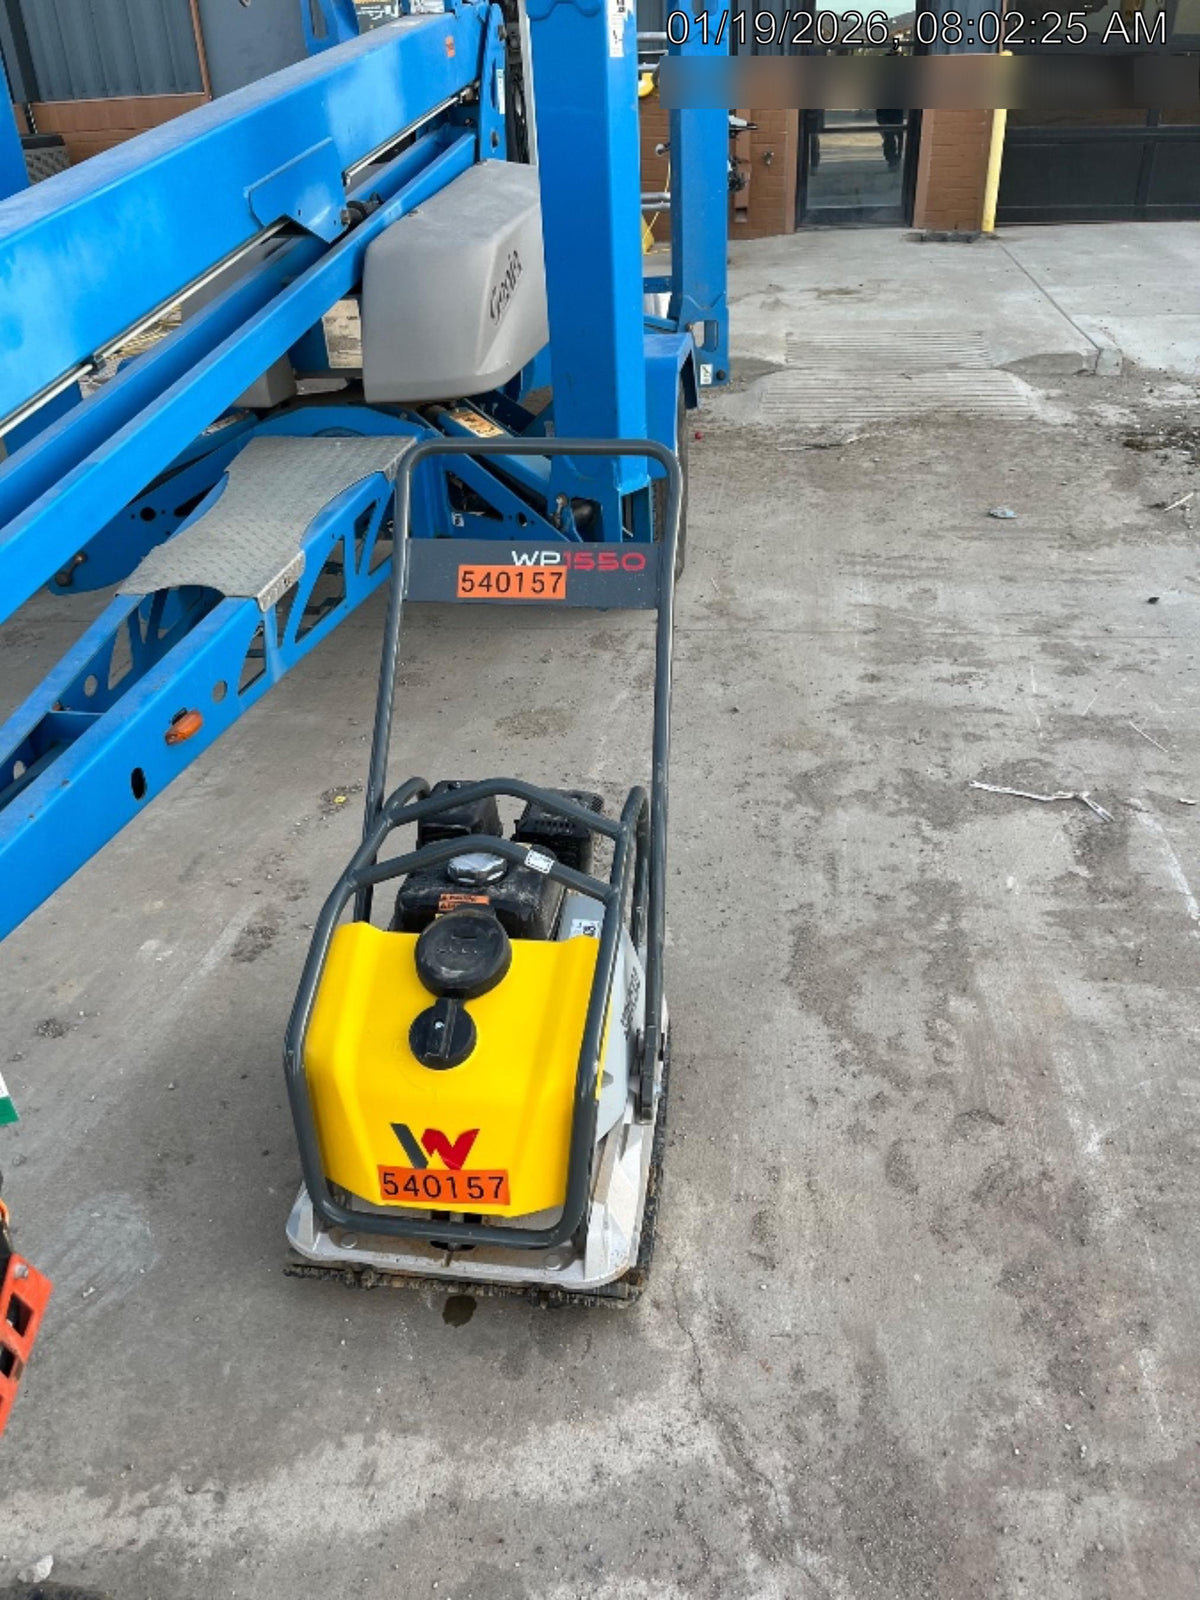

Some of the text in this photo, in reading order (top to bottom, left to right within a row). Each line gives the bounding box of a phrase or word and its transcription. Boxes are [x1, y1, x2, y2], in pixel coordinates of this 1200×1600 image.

[511, 550, 647, 572] WP1550
[461, 570, 563, 593] 540157
[383, 1172, 504, 1199] 540157
